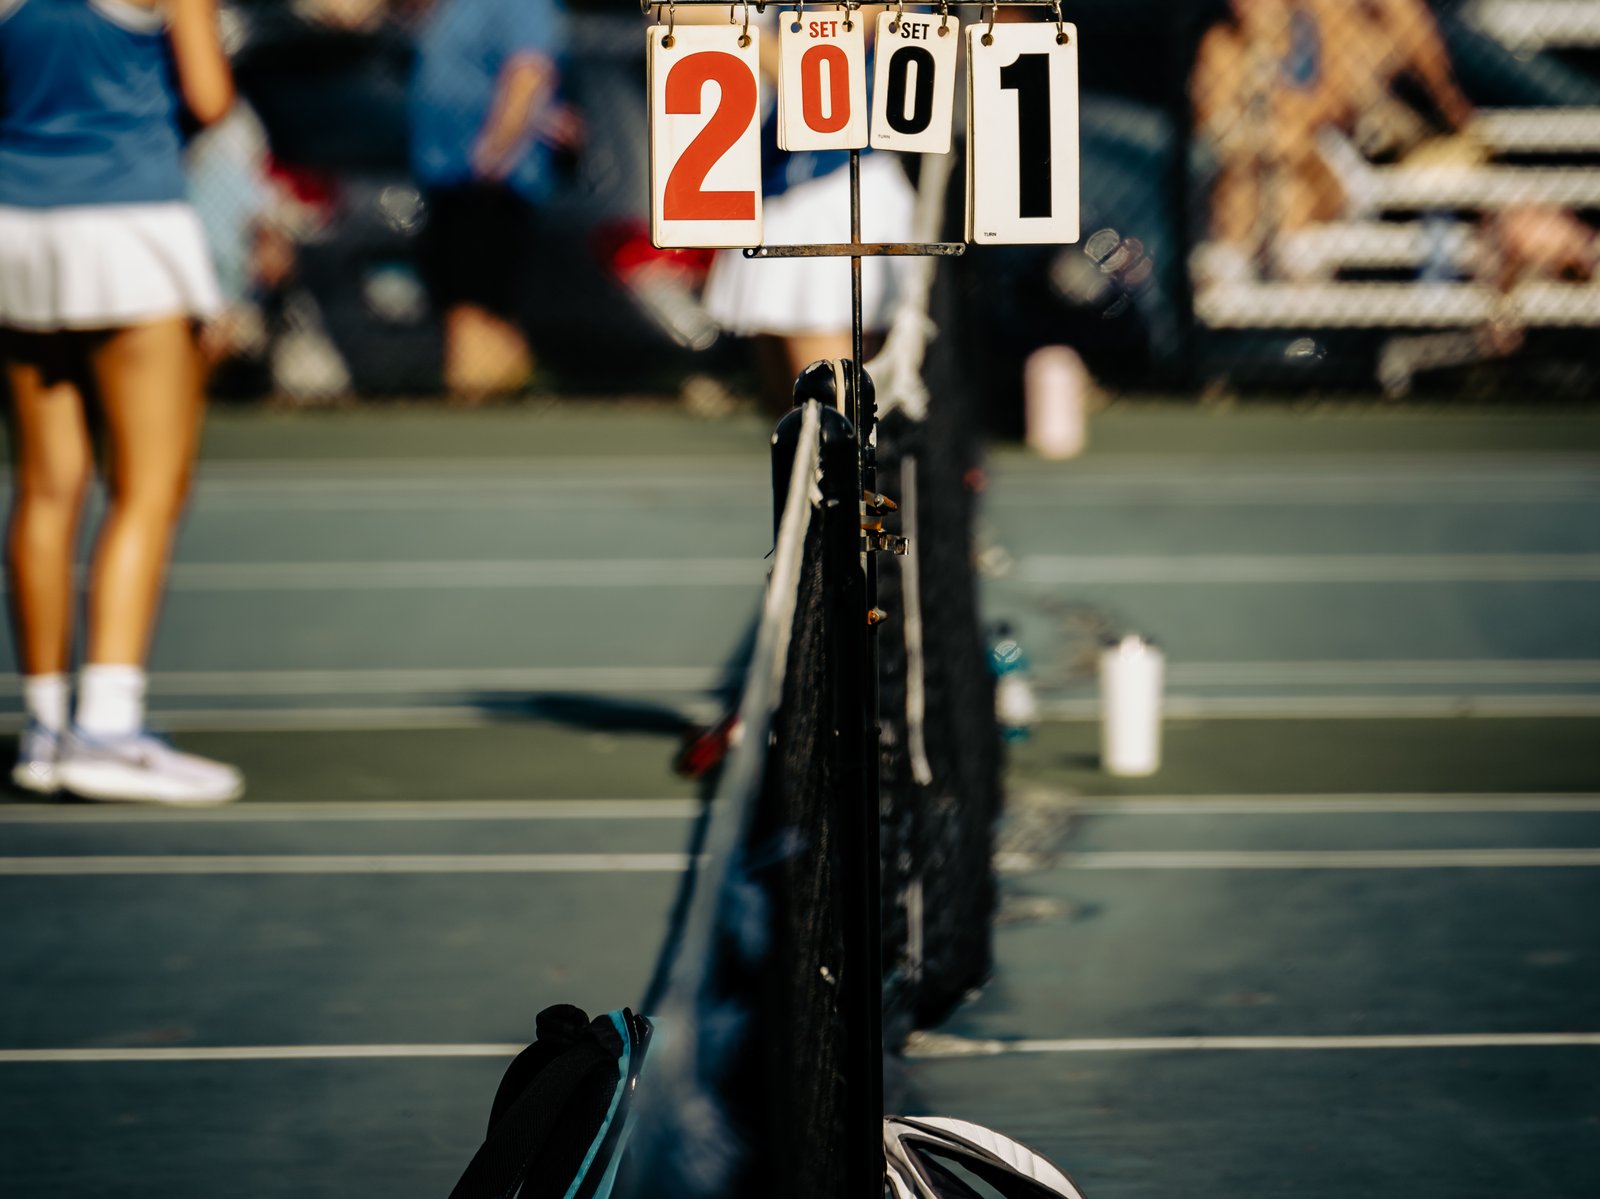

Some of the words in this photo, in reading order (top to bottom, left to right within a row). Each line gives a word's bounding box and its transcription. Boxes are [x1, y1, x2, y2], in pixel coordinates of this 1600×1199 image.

[809, 21, 838, 38] SET
[900, 22, 930, 40] SET
[801, 44, 851, 134] 0
[886, 45, 936, 135] 0
[663, 50, 758, 221] 2
[999, 52, 1053, 219] 1
